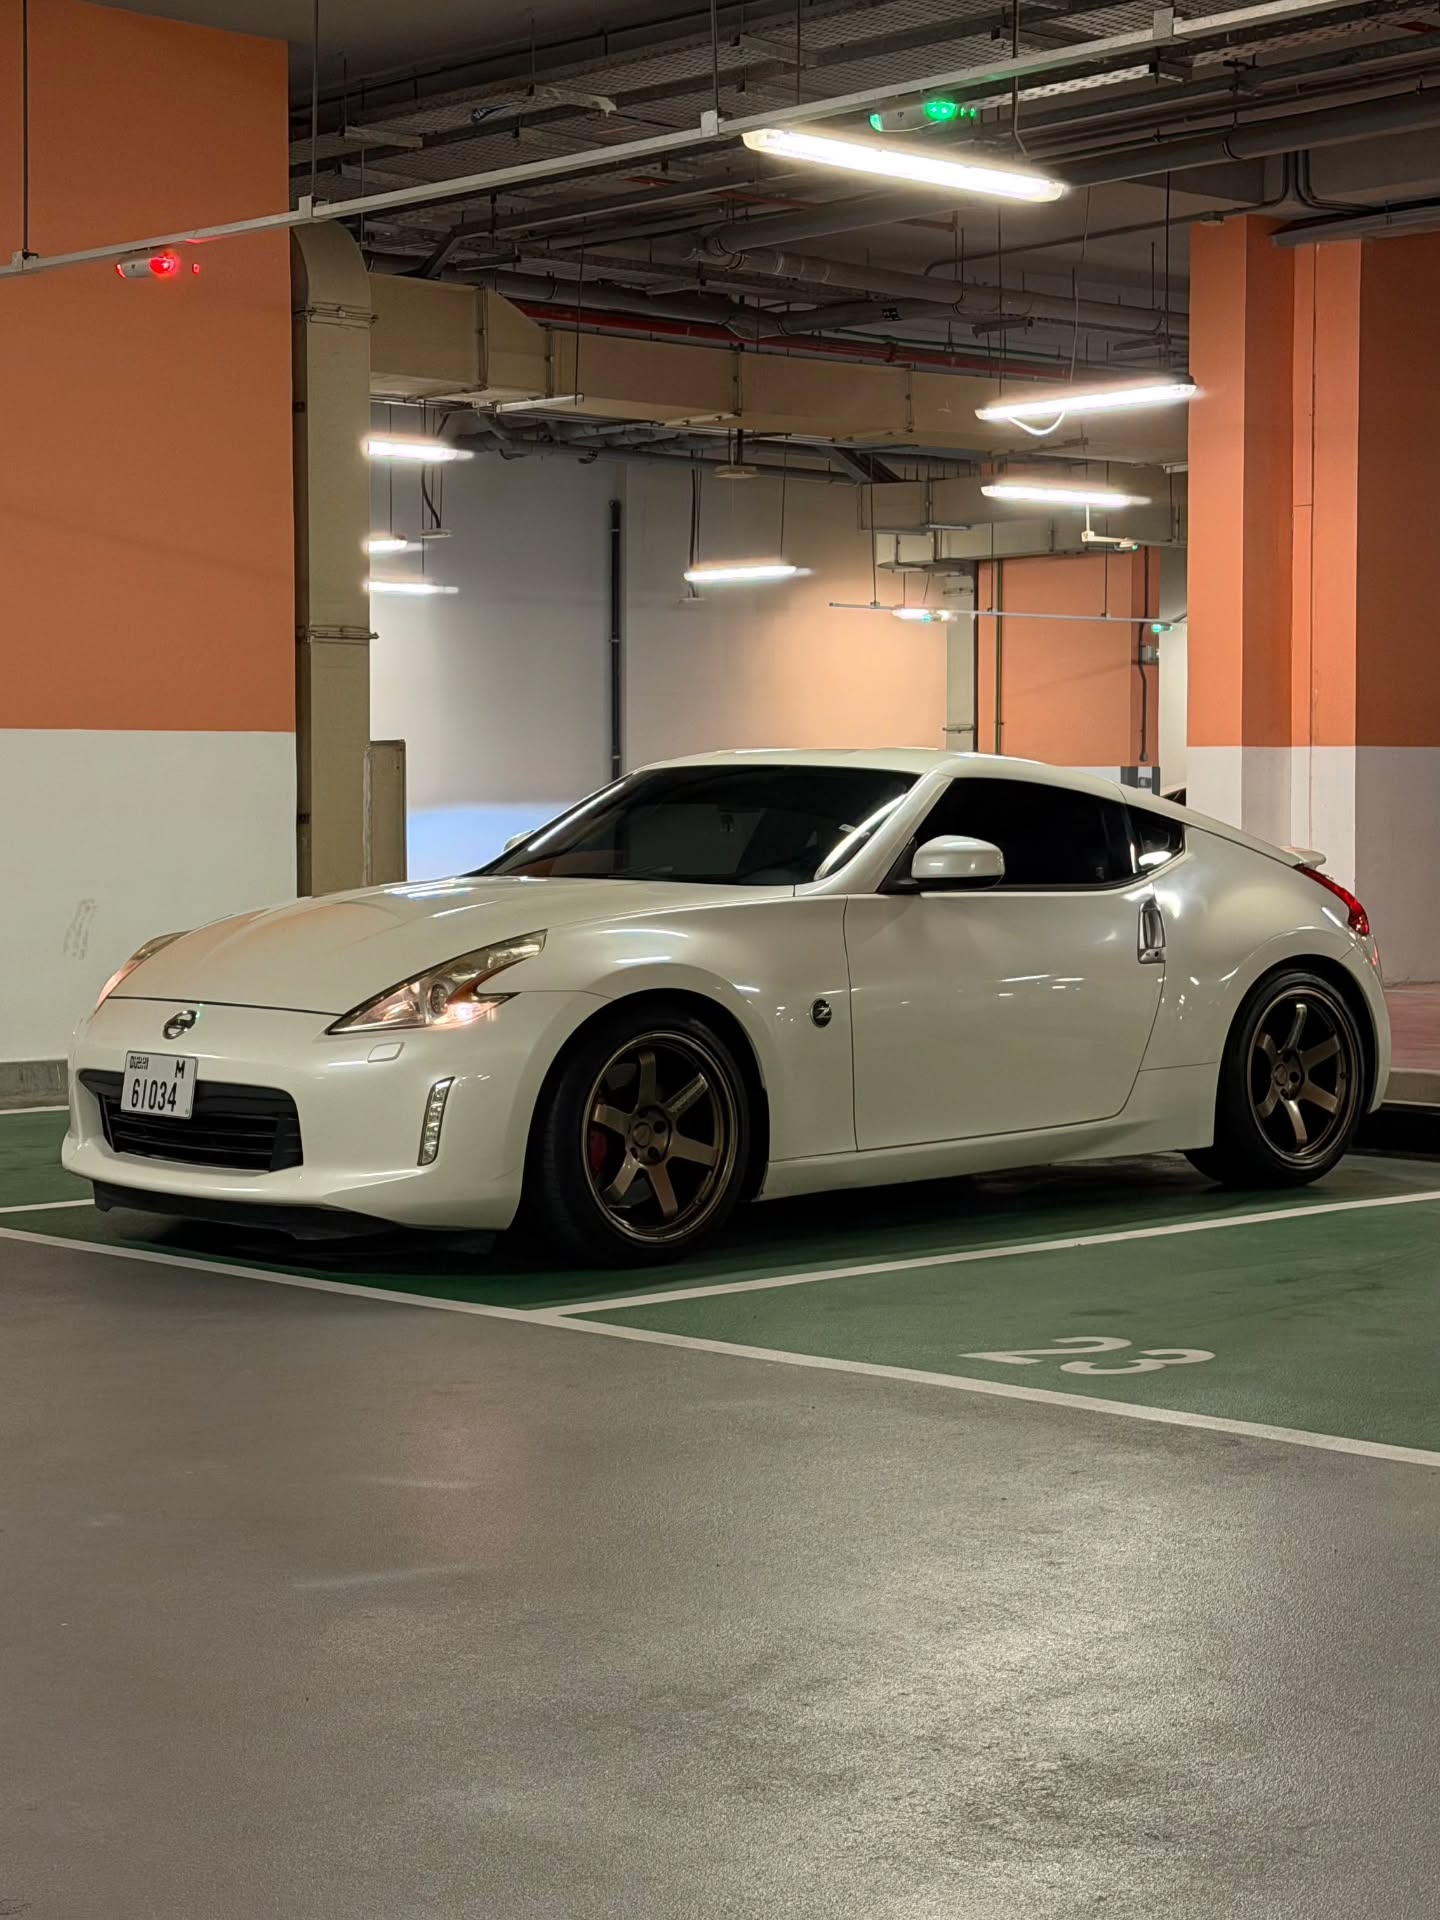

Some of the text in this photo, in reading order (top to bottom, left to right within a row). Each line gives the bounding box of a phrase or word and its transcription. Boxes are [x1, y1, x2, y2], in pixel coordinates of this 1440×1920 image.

[175, 1060, 186, 1079] M
[131, 1078, 177, 1112] 61034
[957, 1336, 1215, 1374] 23
